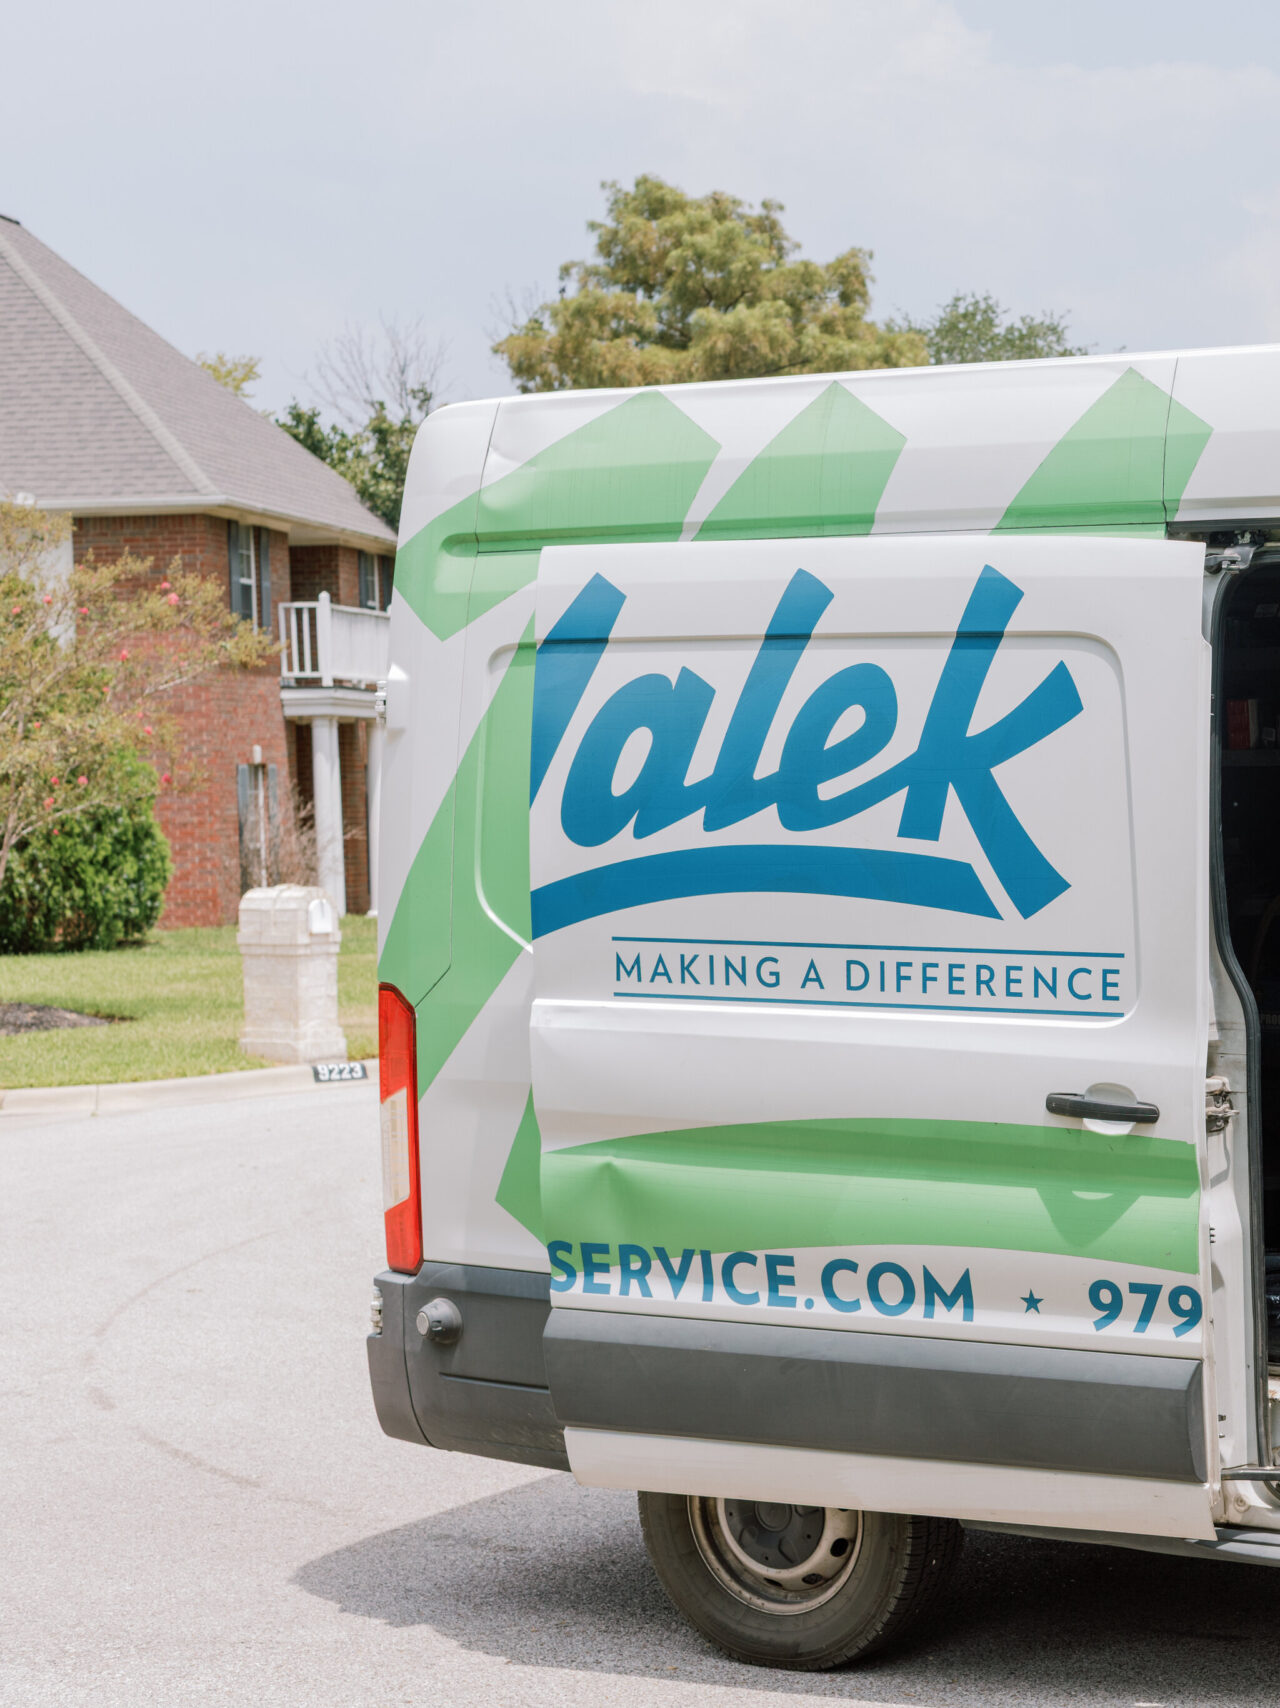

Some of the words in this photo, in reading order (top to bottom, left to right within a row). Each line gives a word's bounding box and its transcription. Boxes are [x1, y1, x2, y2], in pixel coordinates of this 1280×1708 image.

[614, 950, 781, 990] MAKING
[800, 958, 826, 990] A
[845, 959, 1122, 1001] DIFFERENCE
[317, 1062, 363, 1081] 9223
[546, 1239, 976, 1323] SERVICE.COM
[1087, 1278, 1204, 1339] 979
